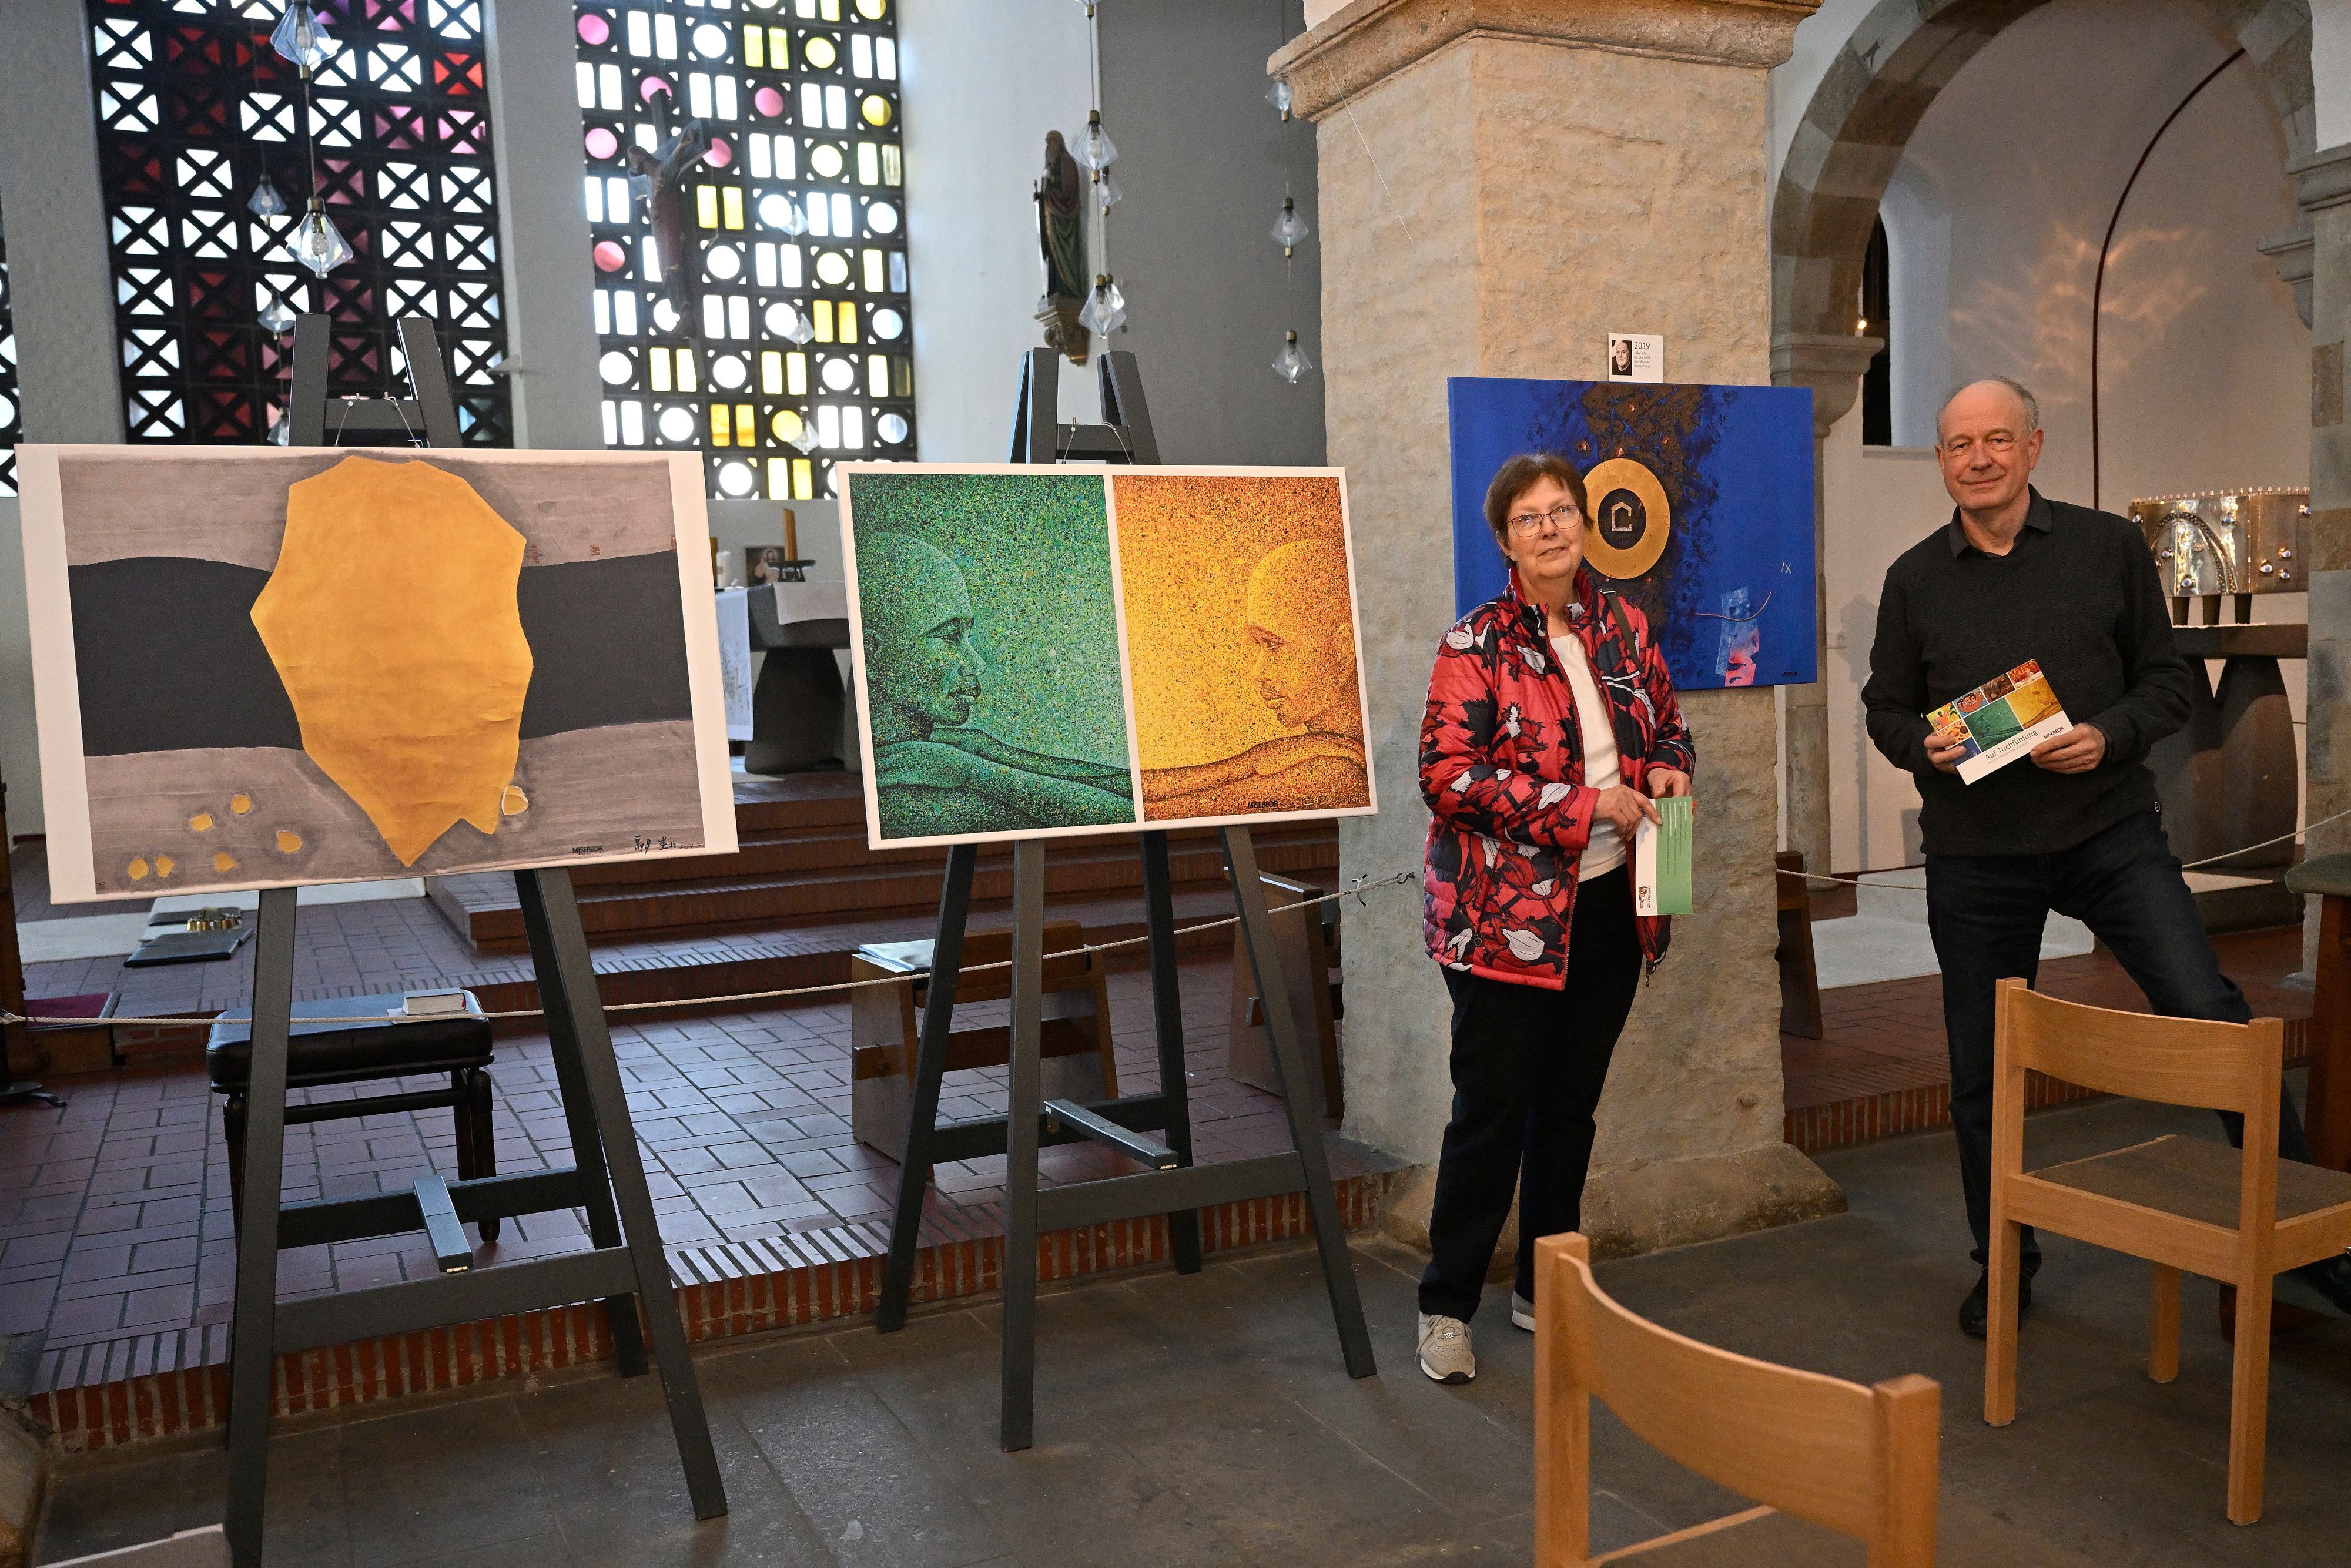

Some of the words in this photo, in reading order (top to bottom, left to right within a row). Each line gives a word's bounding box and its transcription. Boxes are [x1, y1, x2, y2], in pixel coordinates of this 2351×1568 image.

[1634, 341, 1650, 350] 2019
[1781, 562, 1792, 574] IX
[2044, 726, 2064, 739] MISEREOR
[1985, 750, 1997, 760] Auf
[1997, 730, 2038, 754] Tuchfühlung
[1248, 800, 1278, 809] MISEREOR
